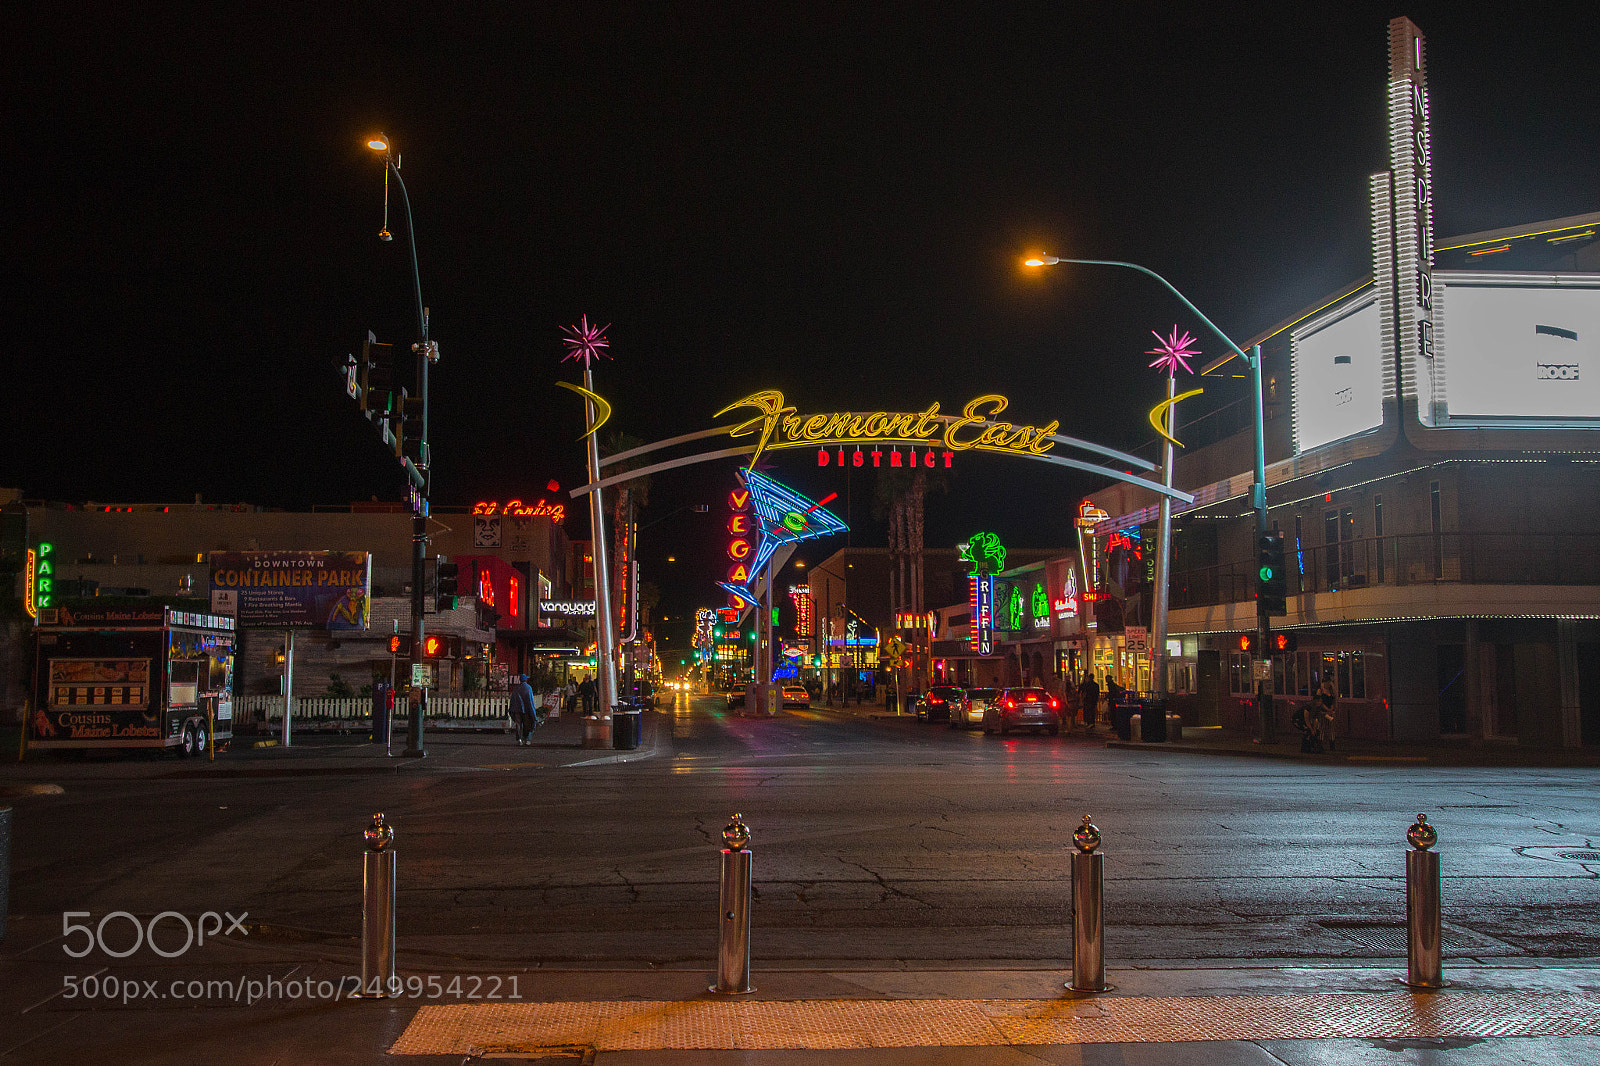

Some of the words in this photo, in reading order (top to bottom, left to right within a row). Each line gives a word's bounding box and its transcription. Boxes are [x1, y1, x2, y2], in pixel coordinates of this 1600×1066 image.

[1414, 36, 1433, 358] INSPIRE
[1537, 366, 1579, 379] ROOF
[713, 390, 941, 473] Fremont
[944, 394, 1060, 452] East
[818, 450, 954, 468] DISTRICT
[730, 490, 751, 610] VEGAS
[254, 560, 324, 568] DOWNTOWN
[38, 544, 50, 607] PARK
[214, 570, 312, 586] CONTAINER
[318, 570, 364, 586] PARK
[540, 600, 596, 615] vanguard
[979, 568, 990, 653] GRIFFIN
[73, 612, 104, 620] Cousins
[106, 612, 131, 620] Maine
[132, 611, 163, 620] Lobster
[1128, 640, 1145, 650] 25
[58, 712, 111, 726] Cousins
[70, 725, 110, 737] Maine
[111, 724, 159, 737] Lobster
